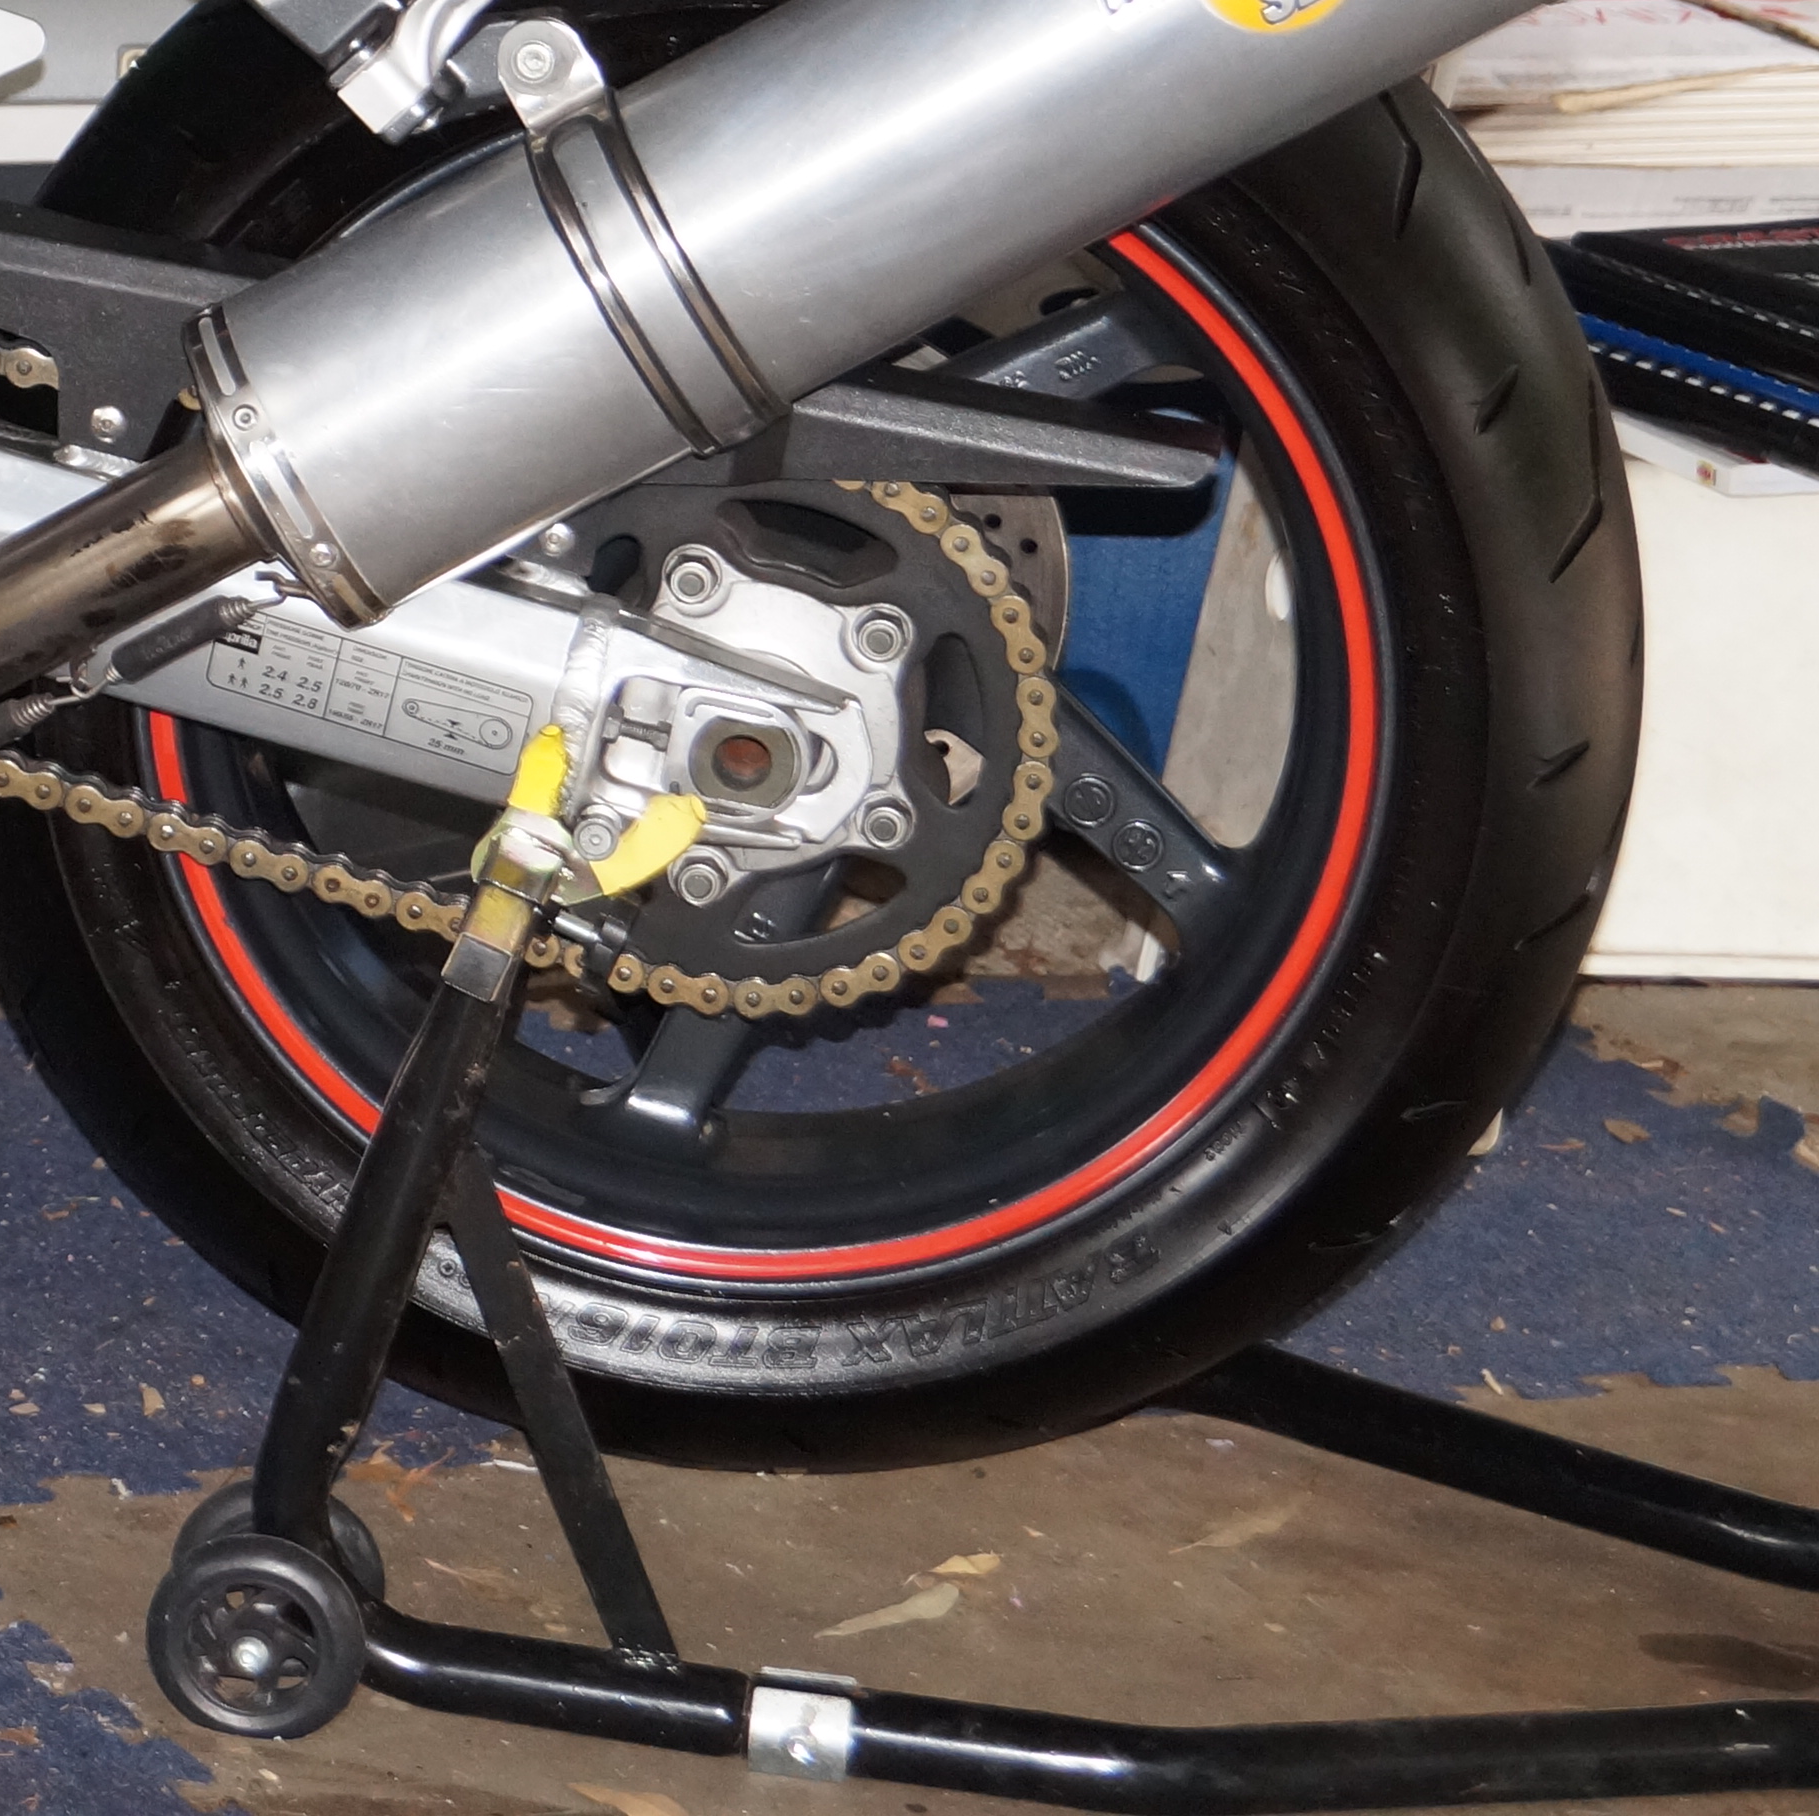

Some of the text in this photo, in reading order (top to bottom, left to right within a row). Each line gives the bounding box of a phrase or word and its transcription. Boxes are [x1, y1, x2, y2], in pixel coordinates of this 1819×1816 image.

[262, 665, 323, 693] 2.4 2.5
[258, 683, 320, 710] 2.5 2.8
